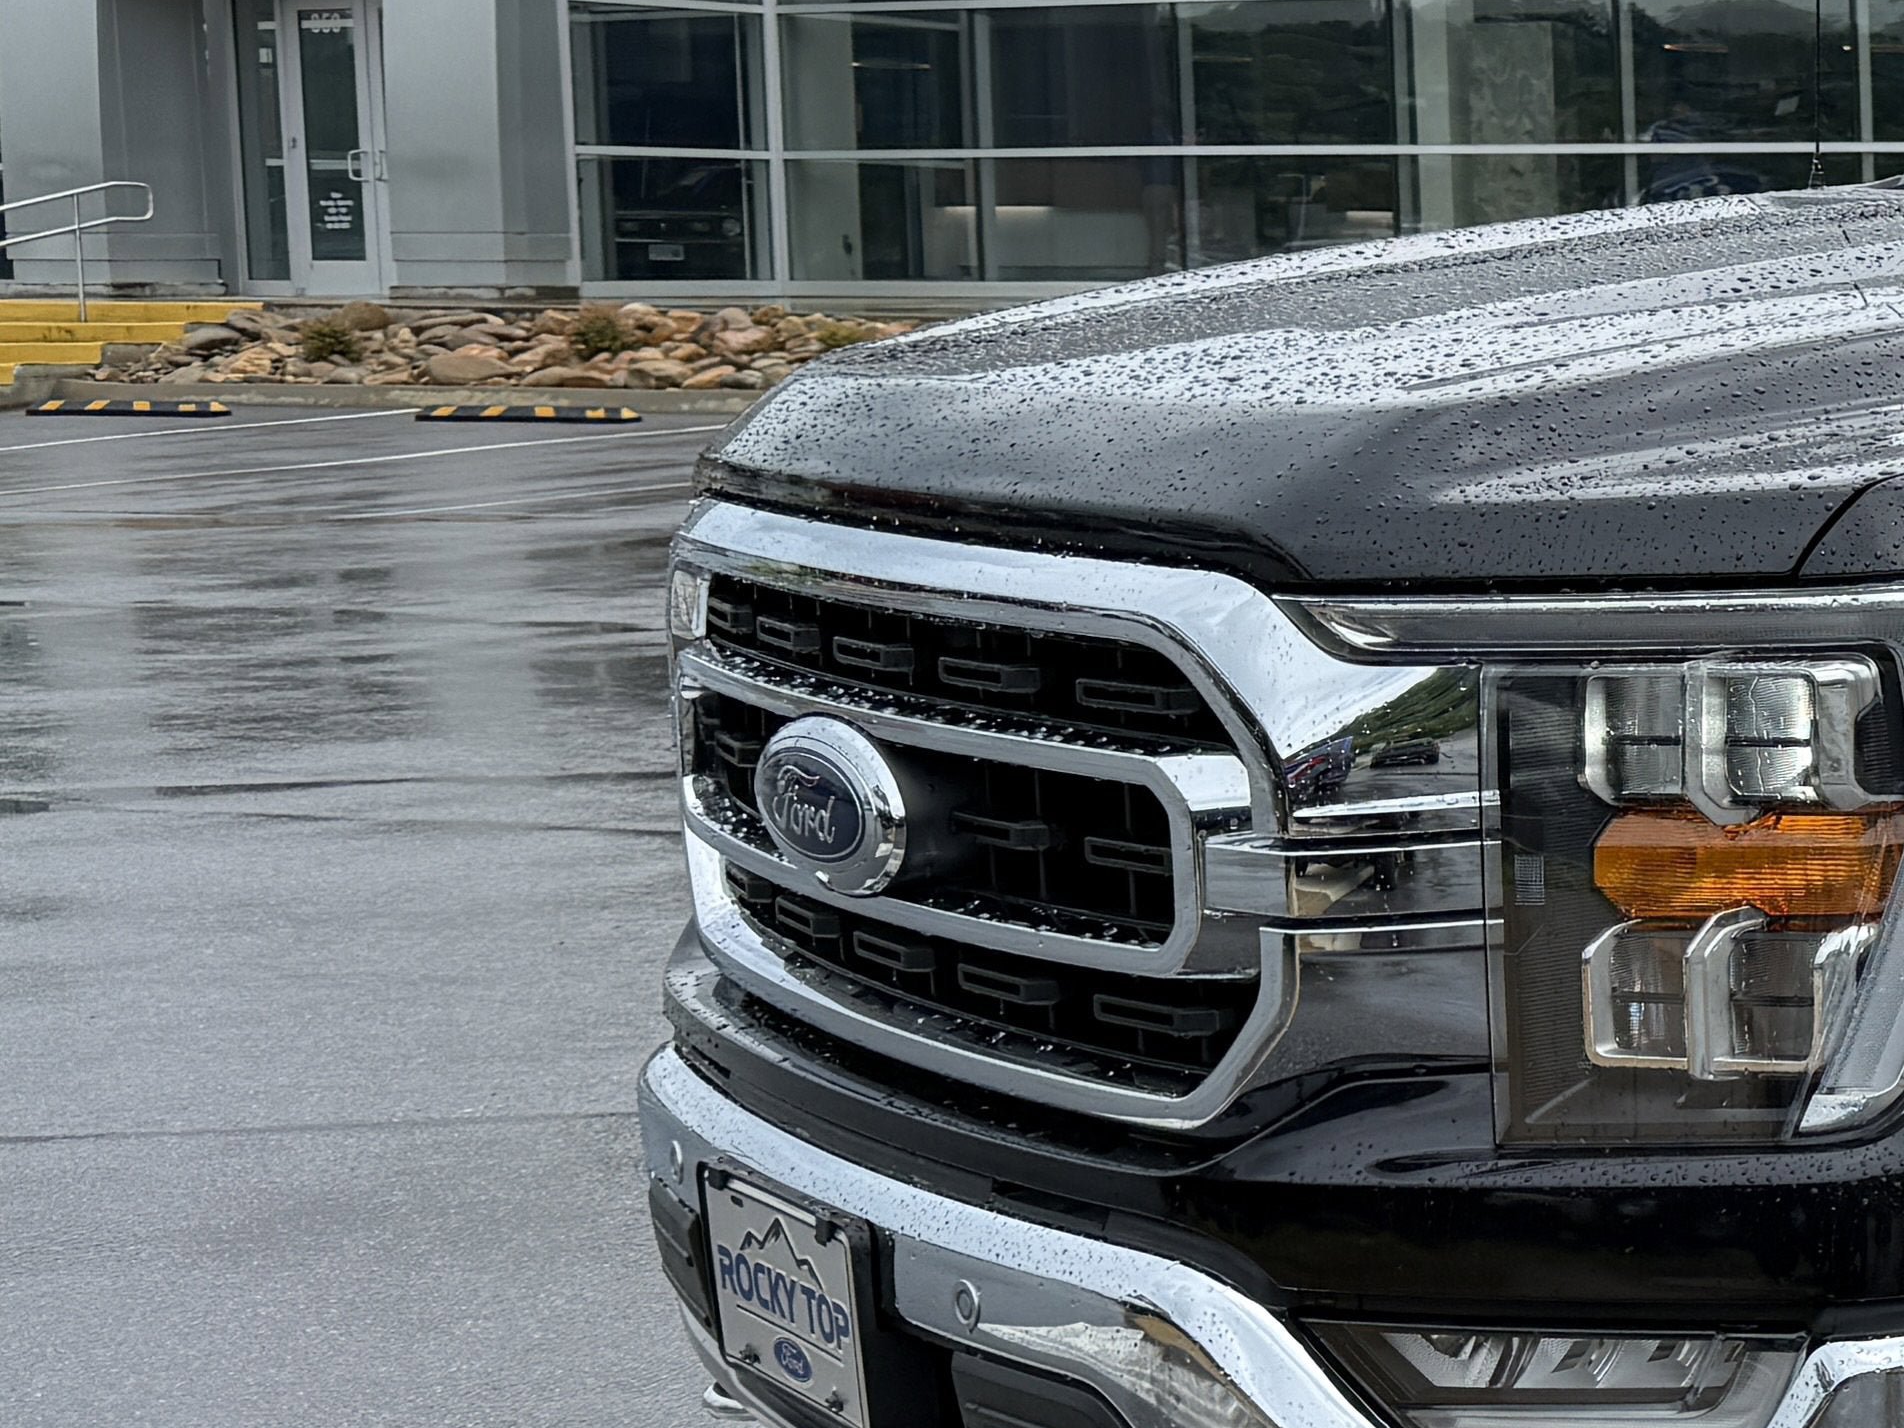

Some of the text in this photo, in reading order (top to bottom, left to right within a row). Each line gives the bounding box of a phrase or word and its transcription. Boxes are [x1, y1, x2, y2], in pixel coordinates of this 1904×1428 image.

[772, 764, 836, 845] Ford
[716, 1244, 850, 1351] ROCKY TOP
[781, 1342, 804, 1375] Ford
